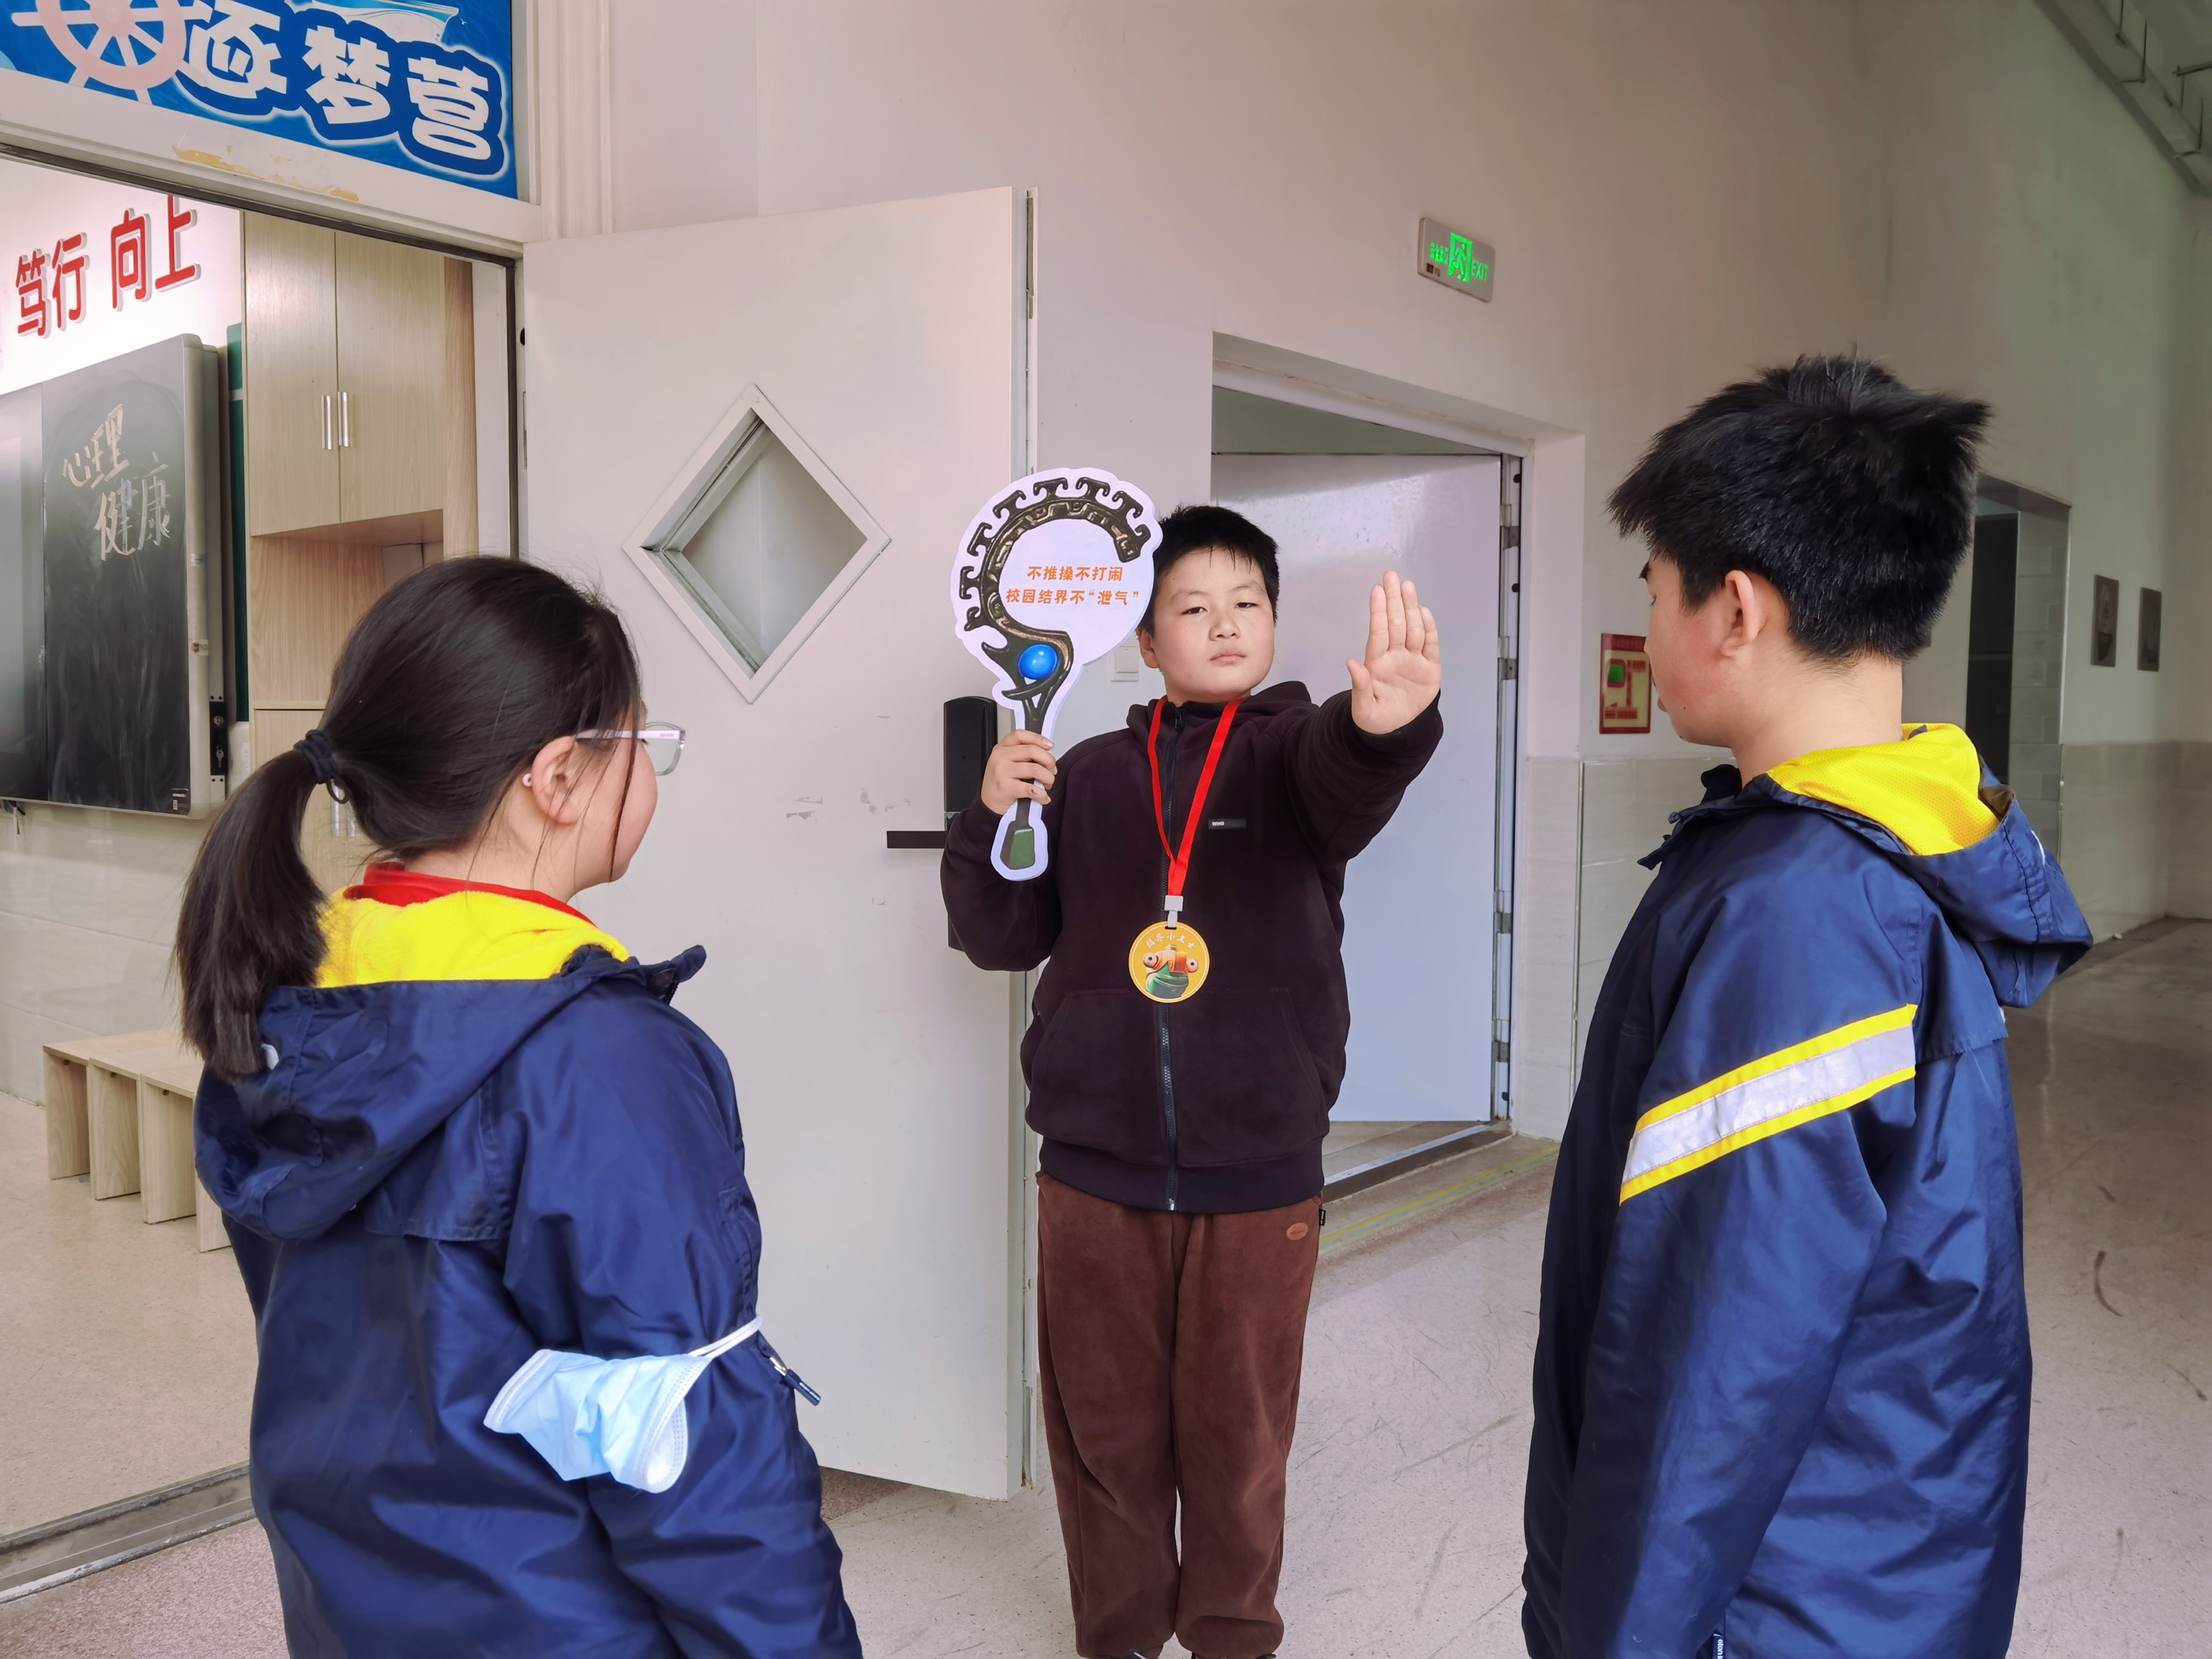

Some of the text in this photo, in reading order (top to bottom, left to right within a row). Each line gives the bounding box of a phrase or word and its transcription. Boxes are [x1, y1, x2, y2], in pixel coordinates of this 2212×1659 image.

[16, 194, 200, 338] 笃行 向上
[1472, 259, 1489, 281] EXIT
[62, 403, 130, 490] 心理
[93, 451, 171, 562] 健康
